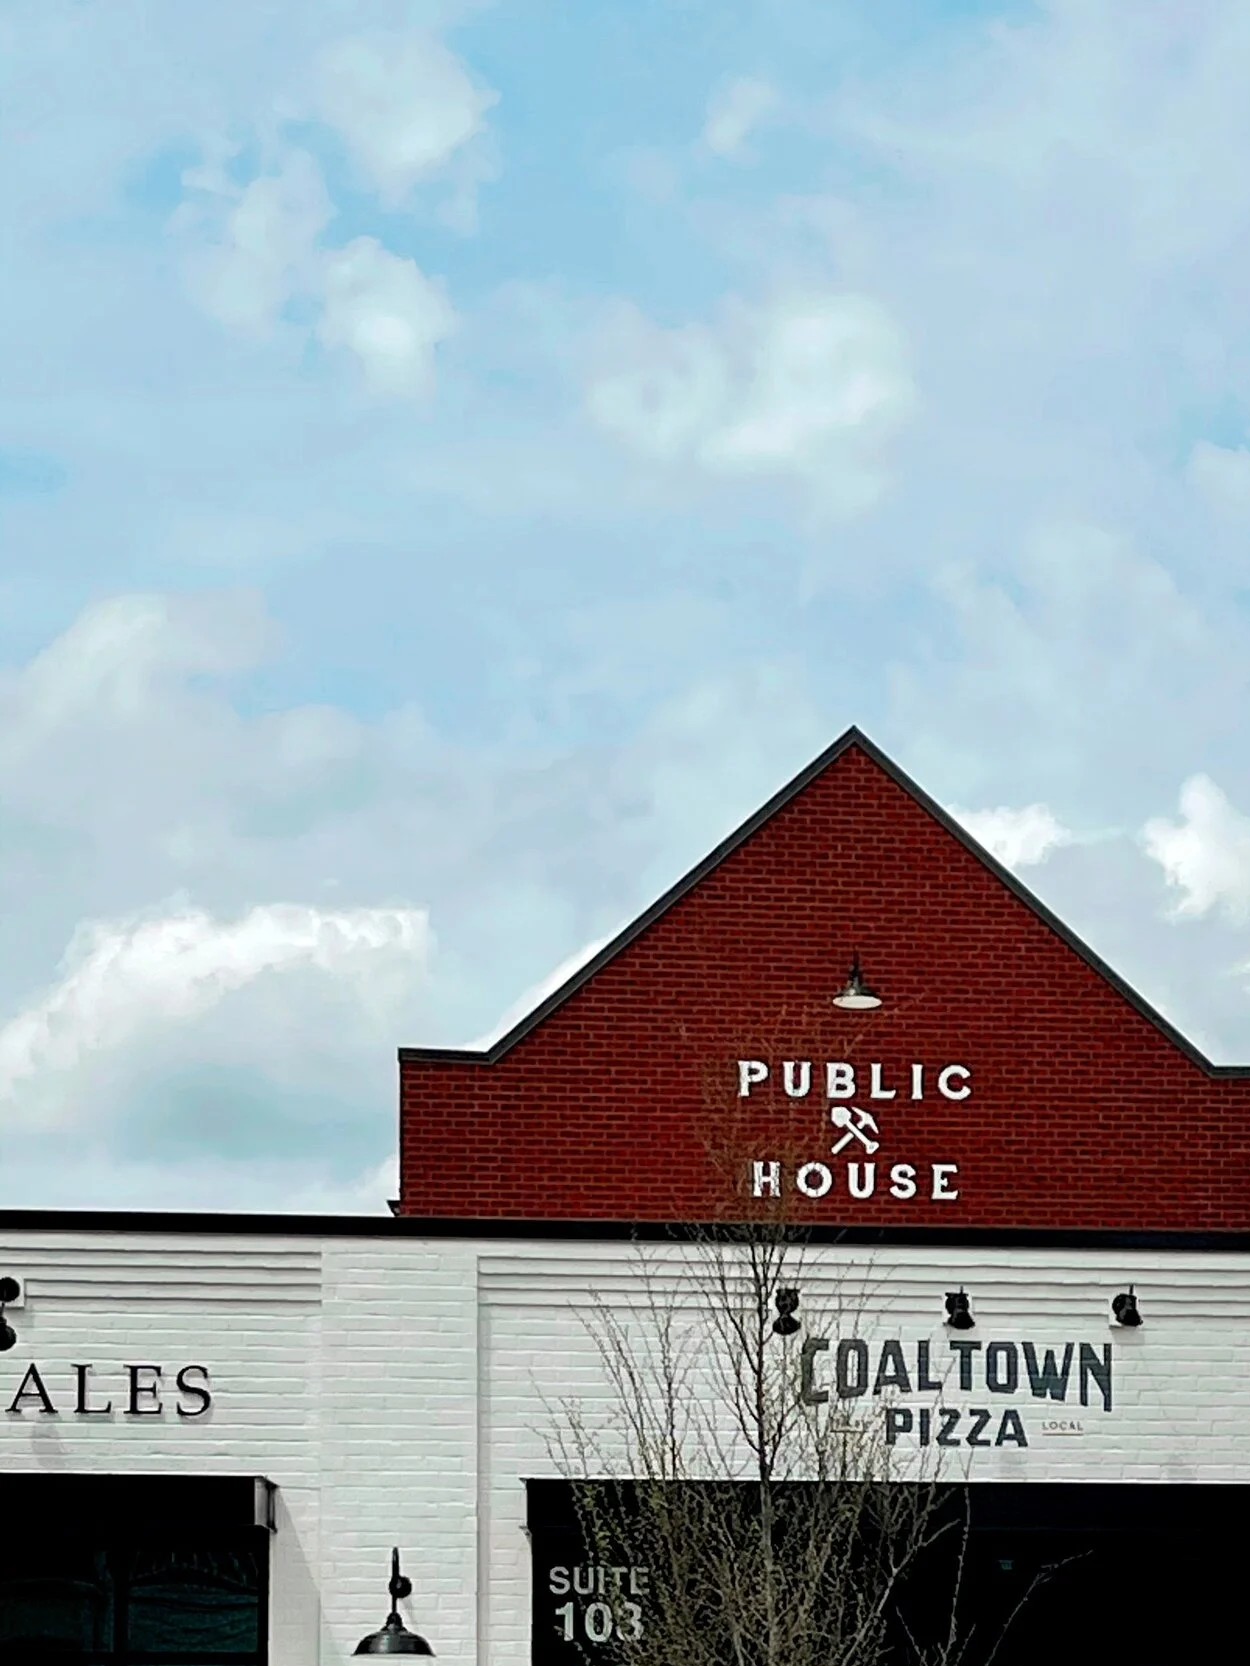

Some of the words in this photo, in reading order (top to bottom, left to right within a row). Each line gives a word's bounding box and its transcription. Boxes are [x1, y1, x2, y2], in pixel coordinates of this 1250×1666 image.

[737, 1060, 972, 1101] PUBLIC
[753, 1160, 959, 1201] HOUSE
[4, 1362, 212, 1416] ALES
[801, 1338, 1113, 1412] COALTOWN
[884, 1408, 1028, 1447] PIZZA
[1041, 1421, 1084, 1431] LOCAL
[548, 1565, 651, 1596] SUITE
[554, 1601, 645, 1643] 103
